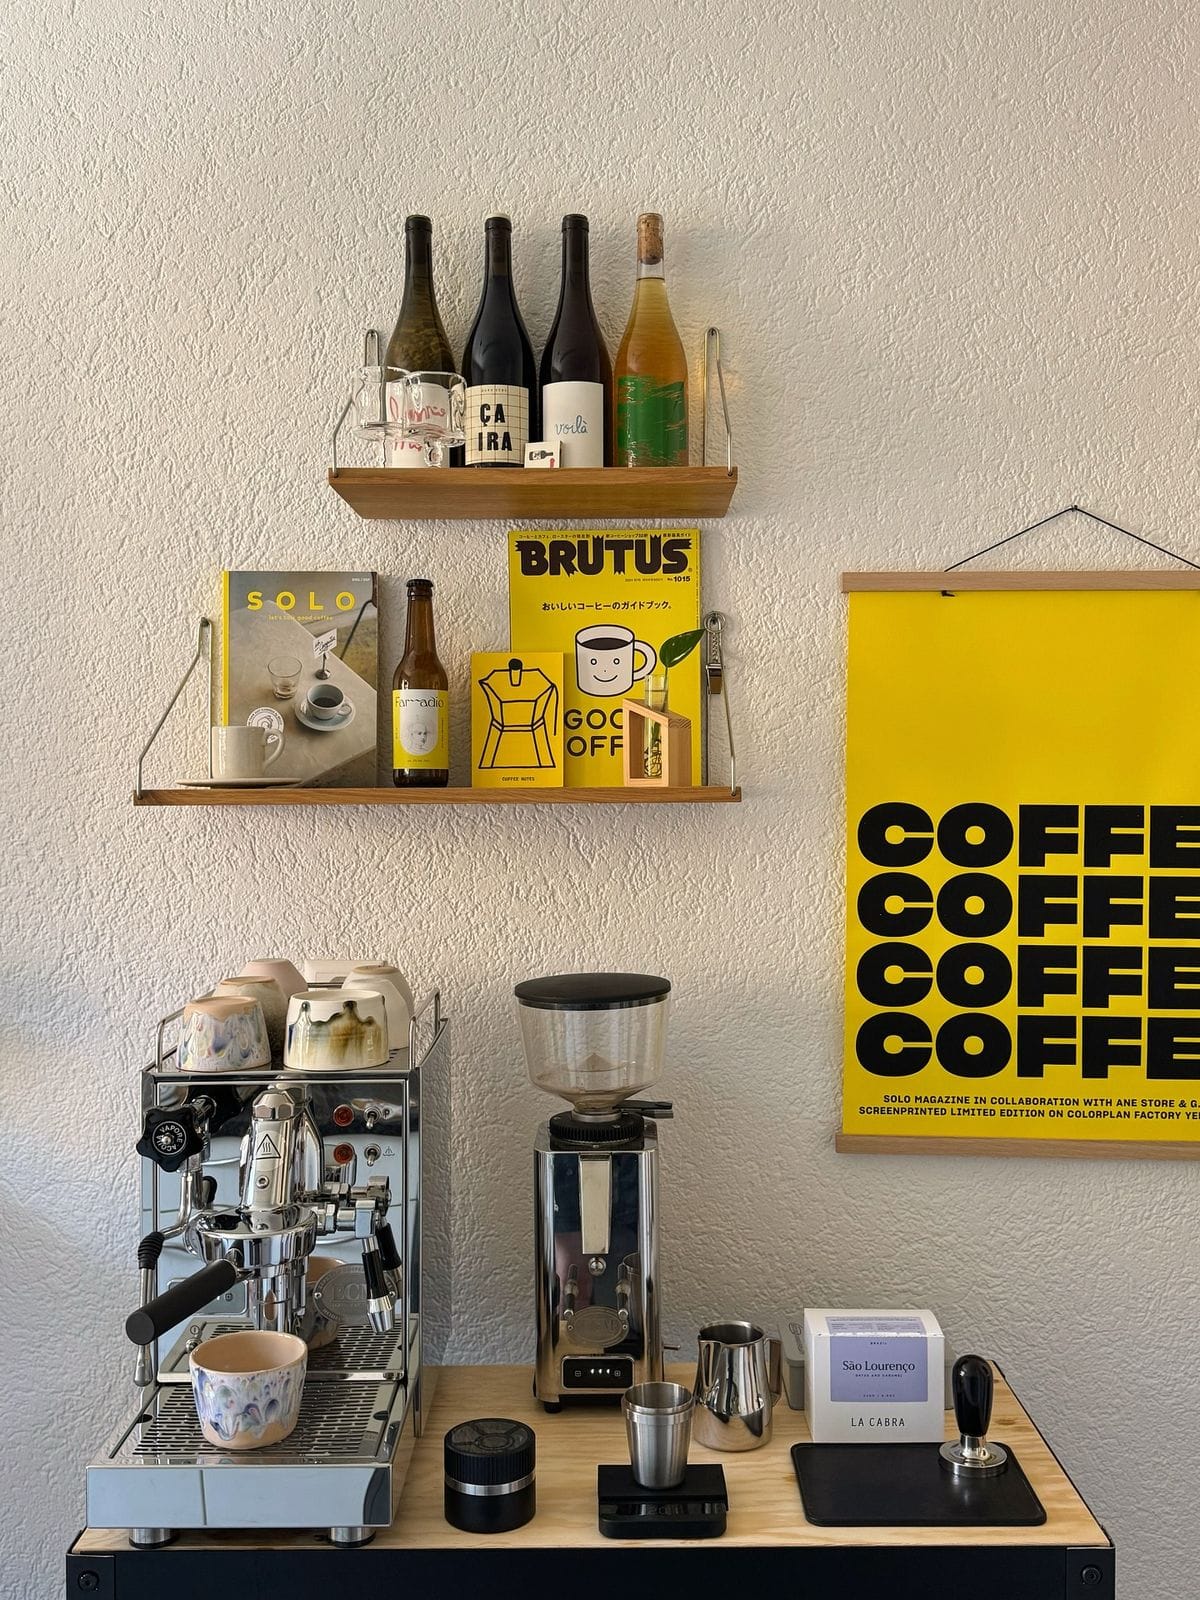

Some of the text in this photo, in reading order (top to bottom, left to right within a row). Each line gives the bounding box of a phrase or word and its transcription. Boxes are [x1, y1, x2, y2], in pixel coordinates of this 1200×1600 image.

[480, 403, 505, 427] ÇA
[555, 414, 589, 435] voilà
[478, 432, 512, 452] IRA
[515, 534, 692, 577] BRUTUS
[247, 591, 355, 612] SOLO
[564, 708, 624, 730] GOO
[566, 735, 624, 757] OFF
[883, 1094, 911, 1104] SOLO
[914, 1095, 970, 1105] MAGAZINE
[974, 1096, 987, 1105] IN
[990, 1096, 1079, 1107] COLLABORATION
[1083, 1098, 1112, 1107] WITH
[1116, 1098, 1137, 1107] ANE
[1141, 1099, 1175, 1108] STORE
[1178, 1099, 1187, 1108] &
[859, 1106, 1200, 1120] SCREENPRINTED LIMITED EDITION ON COLORPLAN FACTORY YE
[159, 1124, 183, 1144] VAPORE
[842, 1360, 915, 1373] São Lourenço
[851, 1417, 905, 1427] LA CABRA
